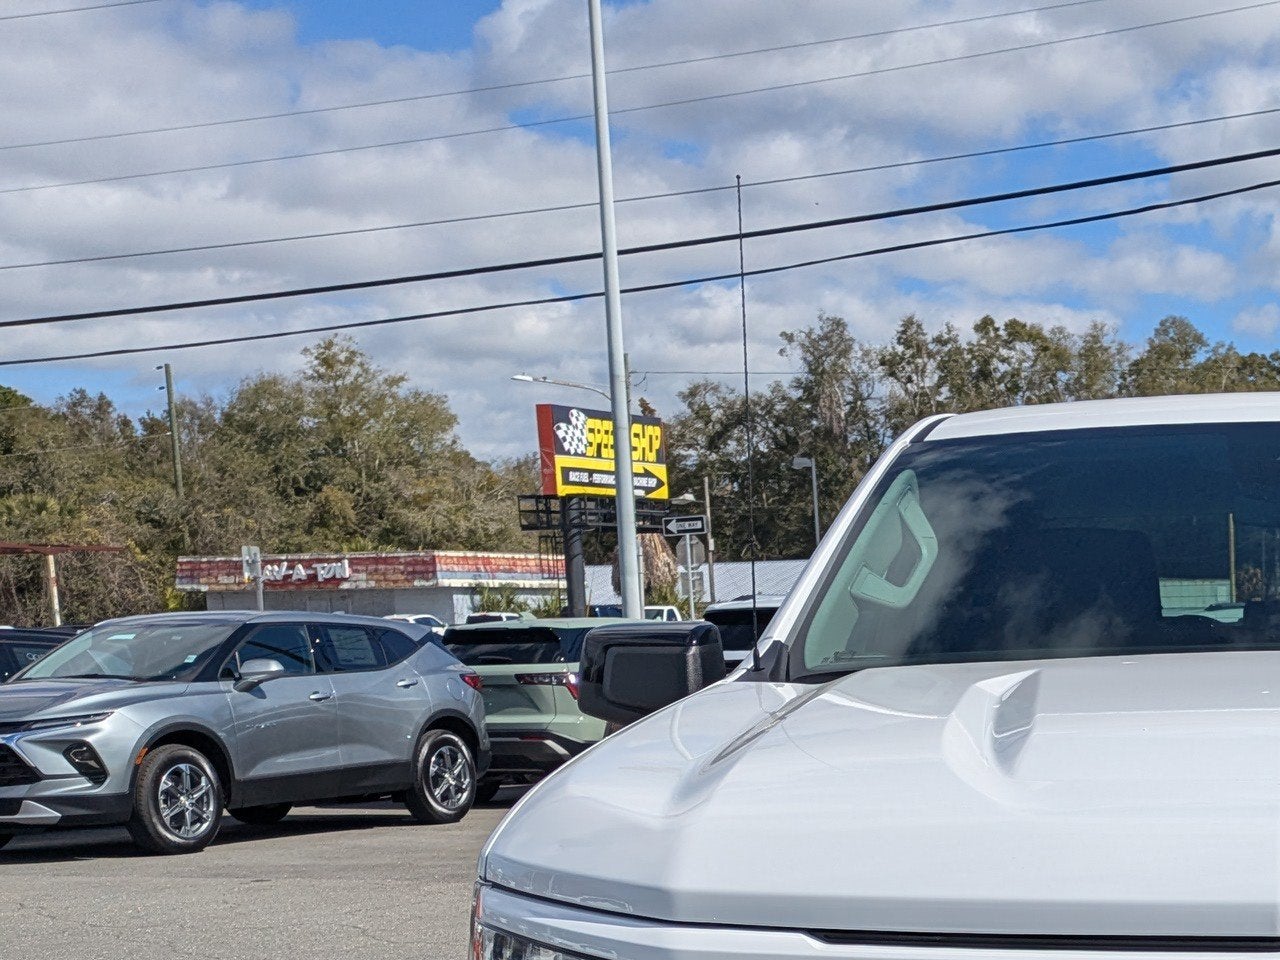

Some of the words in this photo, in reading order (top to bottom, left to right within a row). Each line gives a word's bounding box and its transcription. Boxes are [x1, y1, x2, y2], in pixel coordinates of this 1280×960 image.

[586, 418, 615, 458] SPEE
[631, 423, 661, 462] SHOP
[261, 559, 349, 582] AV-A-TON
